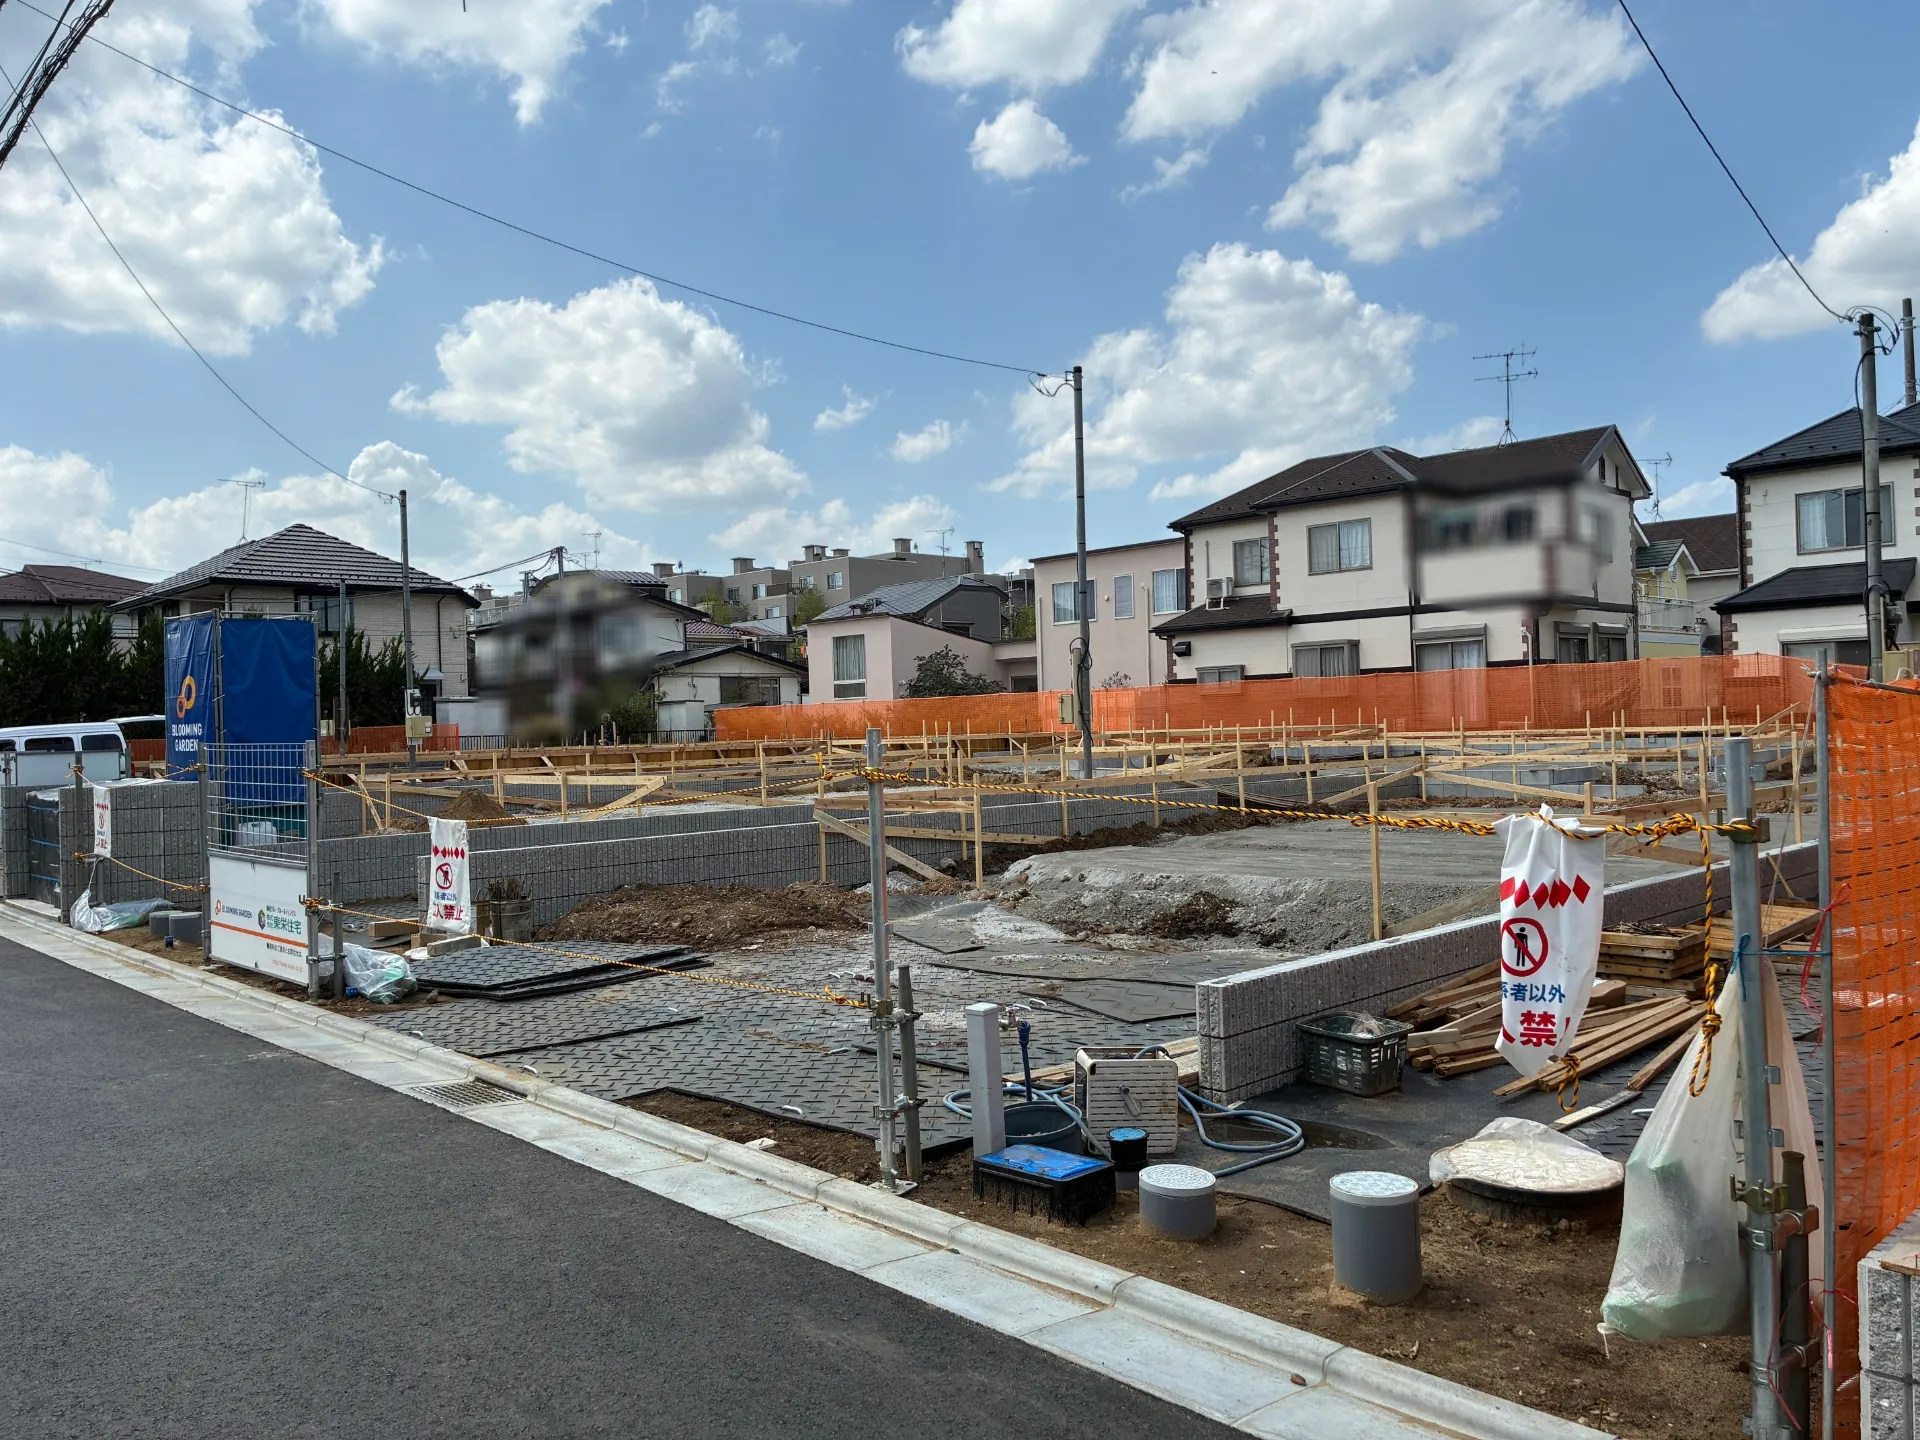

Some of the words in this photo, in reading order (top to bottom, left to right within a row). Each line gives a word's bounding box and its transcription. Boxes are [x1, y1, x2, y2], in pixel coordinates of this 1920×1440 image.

[172, 723, 202, 737] BLOOMING
[175, 739, 199, 752] GARDEN
[273, 916, 302, 935] 東栄住宅
